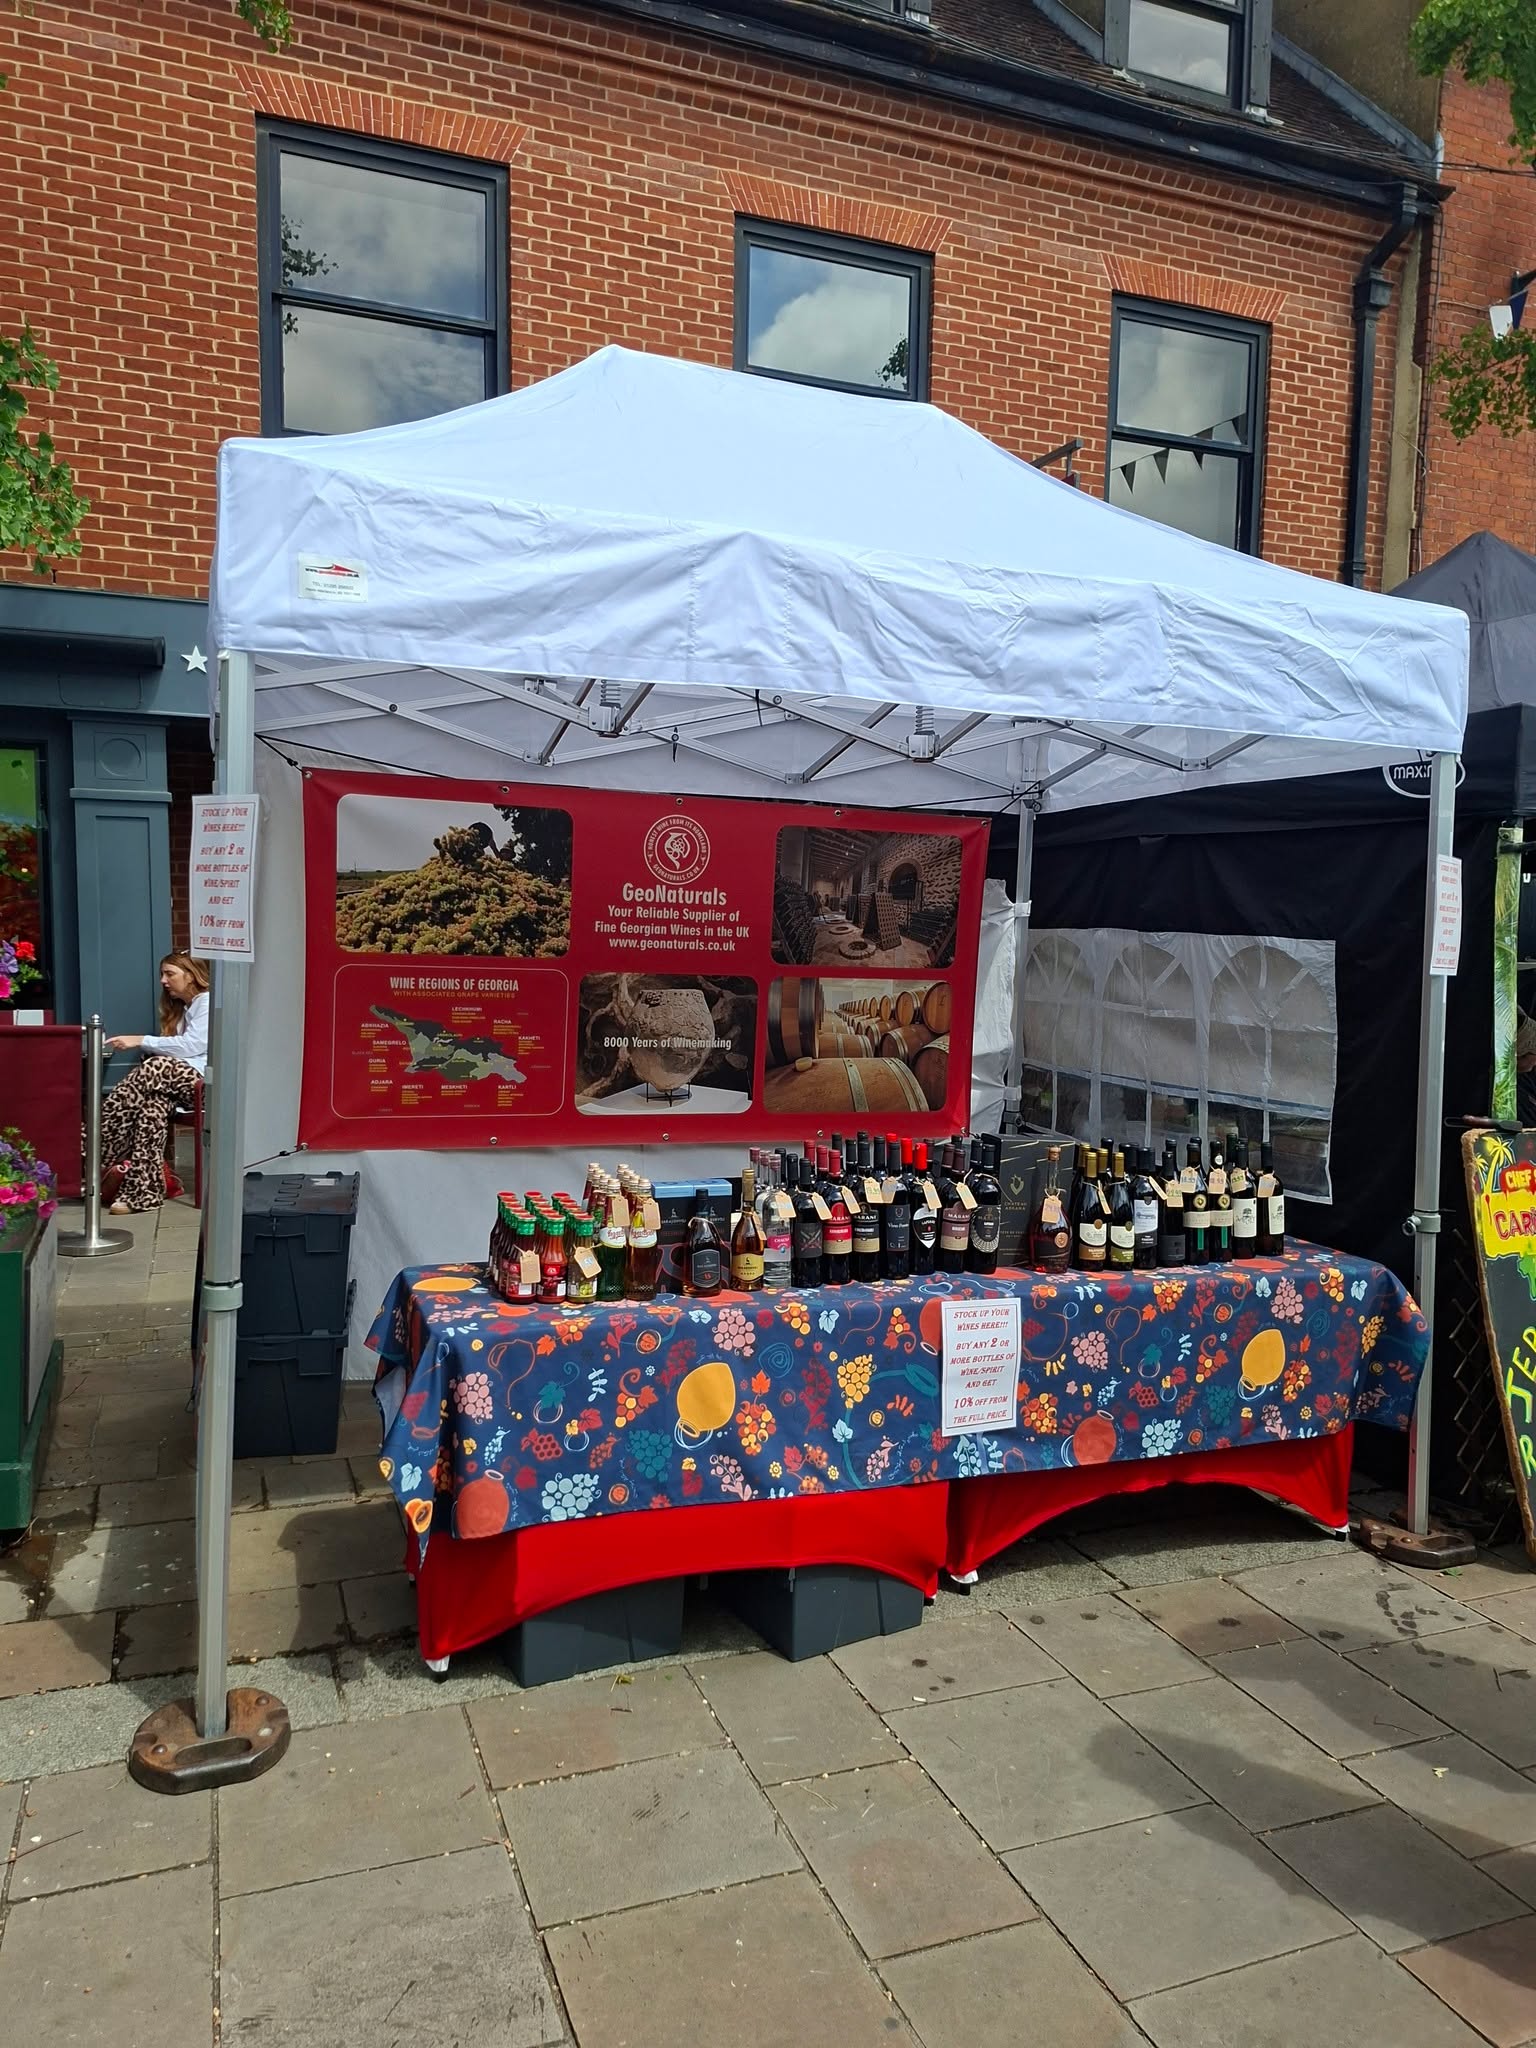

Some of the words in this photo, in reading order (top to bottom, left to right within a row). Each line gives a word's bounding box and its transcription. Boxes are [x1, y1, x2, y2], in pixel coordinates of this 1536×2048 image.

[201, 808, 220, 817] STOCK
[231, 807, 248, 816] YOUR
[203, 823, 221, 832] WINES
[648, 830, 658, 850] HONEST
[656, 821, 669, 831] WINE
[684, 820, 692, 828] ITS
[200, 846, 214, 855] BUY
[213, 845, 228, 855] ANY
[228, 843, 235, 855] 2
[236, 847, 245, 855] OR
[195, 864, 212, 872] MORE
[213, 864, 239, 872] BOTTLES
[240, 864, 249, 872] OF
[208, 896, 221, 904] AND
[622, 882, 727, 906] GeoNaturals
[608, 905, 633, 918] Your
[636, 906, 680, 920] Reliable
[682, 908, 726, 923] Supplier
[729, 910, 740, 922] of
[200, 914, 216, 927] 10%
[216, 919, 228, 928] OFF
[228, 920, 245, 928] FROM
[594, 921, 617, 933] Fine
[620, 922, 667, 937] Georgian
[670, 924, 701, 936] Wines
[704, 926, 714, 937] in
[717, 926, 733, 937] the
[736, 927, 750, 938] UK
[199, 936, 210, 944] THE
[210, 937, 224, 946] FULL
[609, 938, 736, 952] www.geonaturals.co.uk
[390, 977, 415, 989] WINE
[418, 978, 460, 990] REGIONS
[463, 979, 475, 990] OF
[478, 979, 519, 991] GEORGIA
[603, 1037, 629, 1048] 8000
[632, 1037, 658, 1048] Years
[661, 1037, 670, 1048] of
[673, 1037, 732, 1051] Winemaking
[1506, 1169, 1531, 1189] CHEF
[953, 1310, 978, 1319] STOCK
[980, 1309, 989, 1317] UP
[991, 1308, 1010, 1316] YOUR
[957, 1322, 979, 1331] WINES
[981, 1321, 1008, 1330] HERE!!!
[956, 1341, 973, 1350] BUY
[972, 1340, 989, 1349] ANY
[991, 1337, 998, 1347] 2
[950, 1357, 971, 1365] MORE
[972, 1354, 1005, 1363] BOTTLES
[960, 1366, 1005, 1376] WINE/SPIRIT
[965, 1380, 980, 1389] AND
[982, 1379, 998, 1387] GET
[954, 1396, 974, 1409] 10%
[974, 1398, 989, 1406] OFF
[988, 1395, 1008, 1404] FROM
[953, 1416, 968, 1424] THE
[968, 1413, 985, 1422] FULL
[986, 1410, 1008, 1419] PRICE
